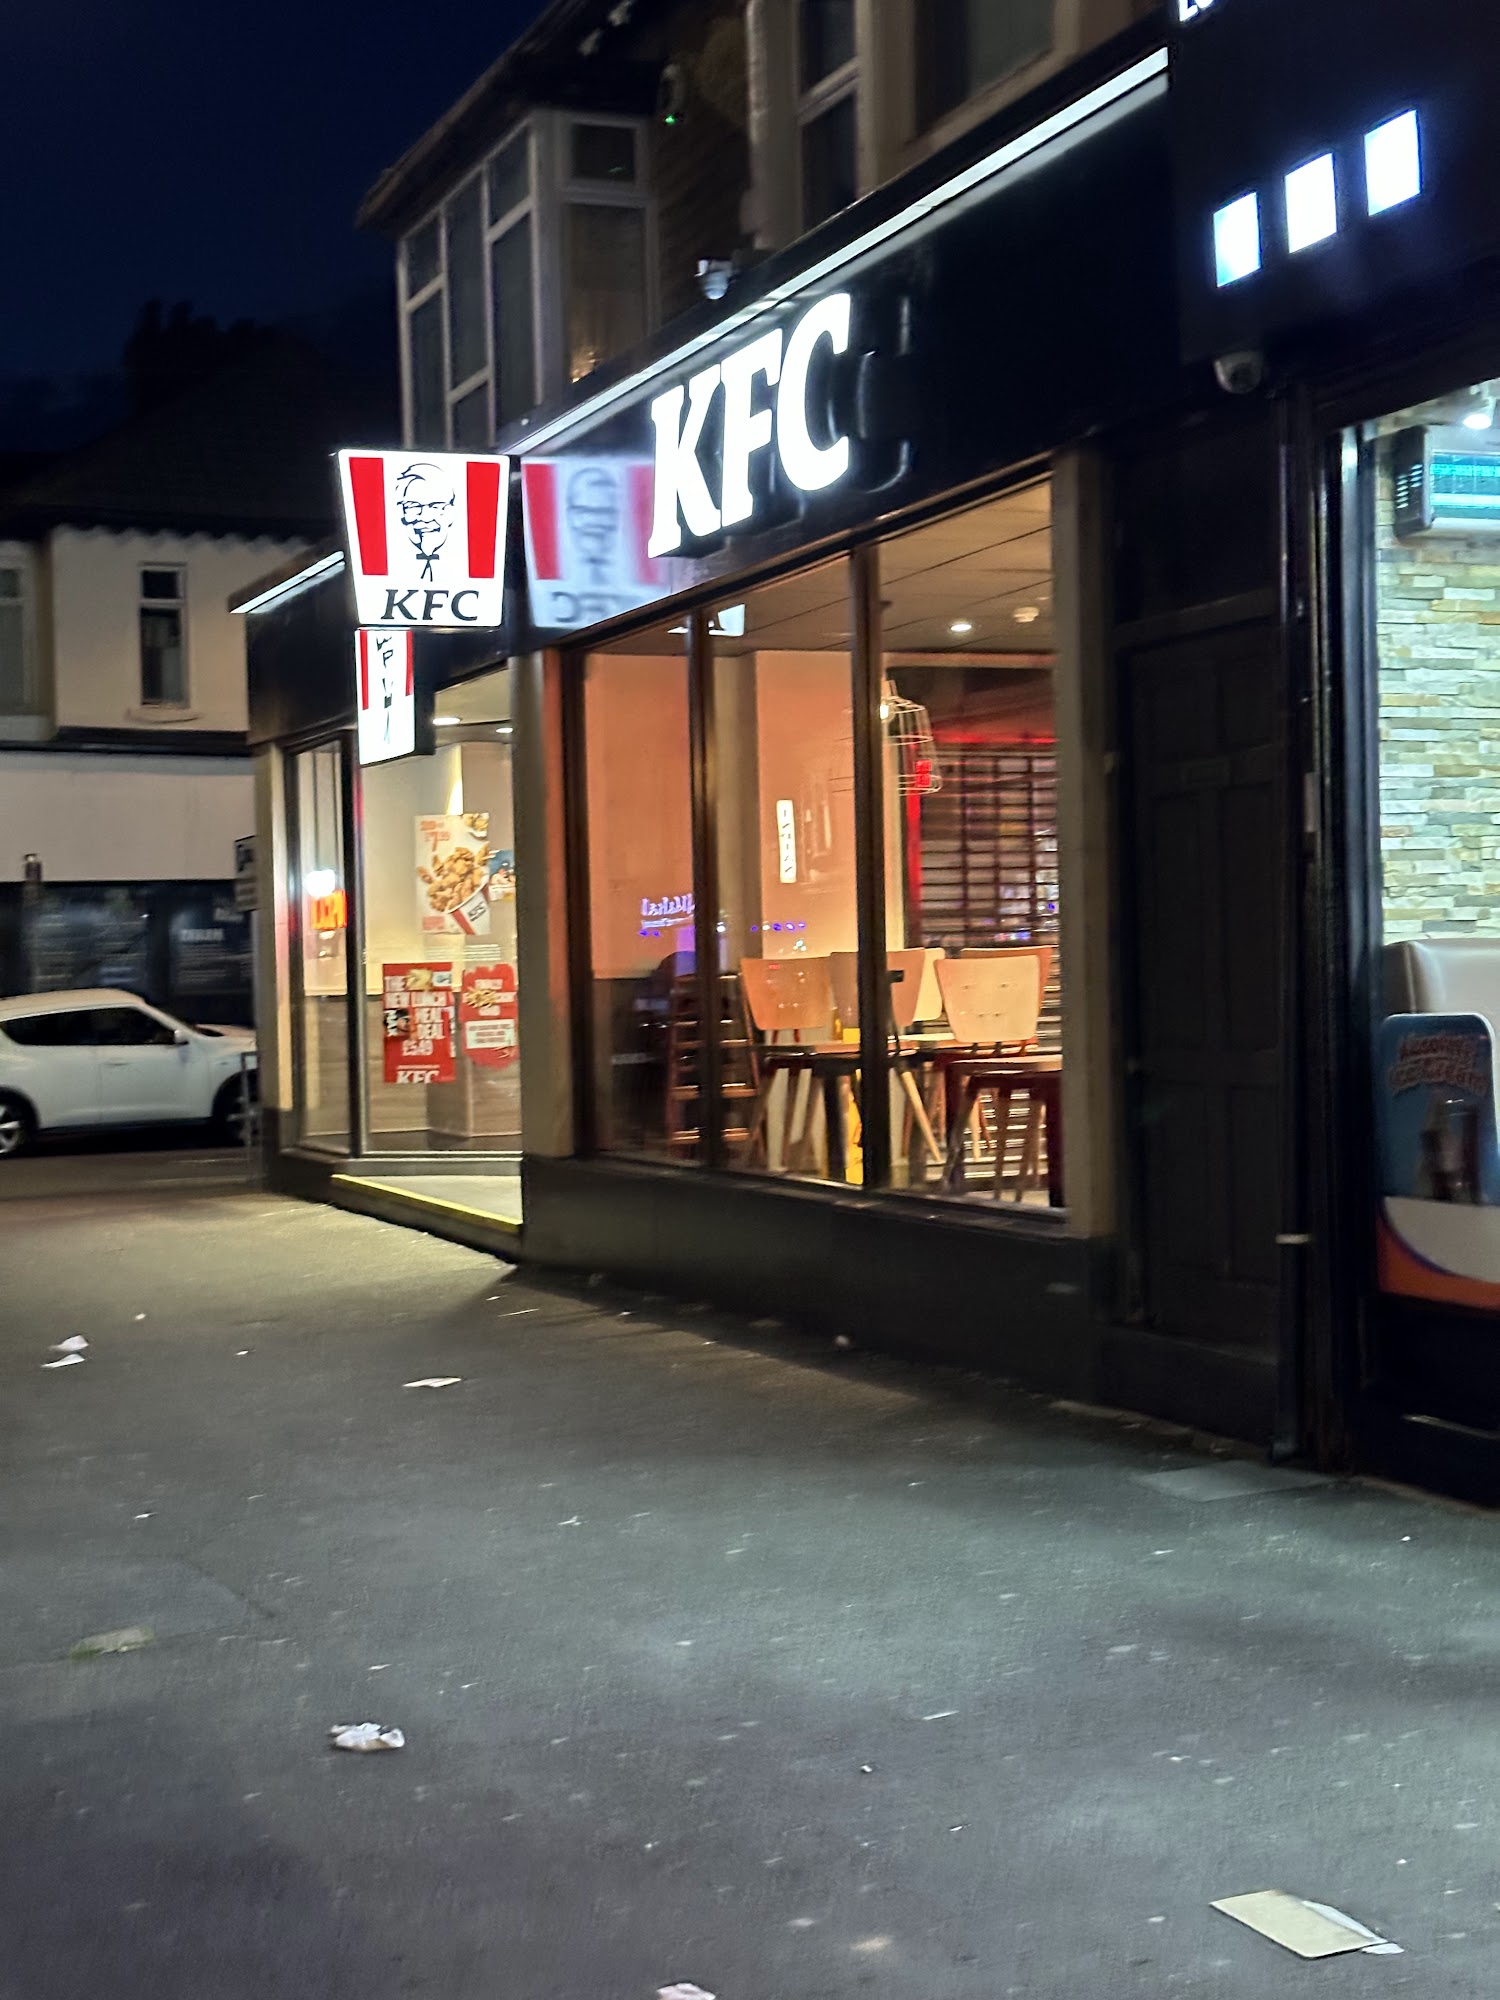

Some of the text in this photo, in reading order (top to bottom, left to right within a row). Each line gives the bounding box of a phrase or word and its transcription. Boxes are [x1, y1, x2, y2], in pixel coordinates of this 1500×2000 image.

[648, 292, 851, 558] KFC
[380, 588, 480, 622] KFC
[396, 1070, 440, 1083] KFC
